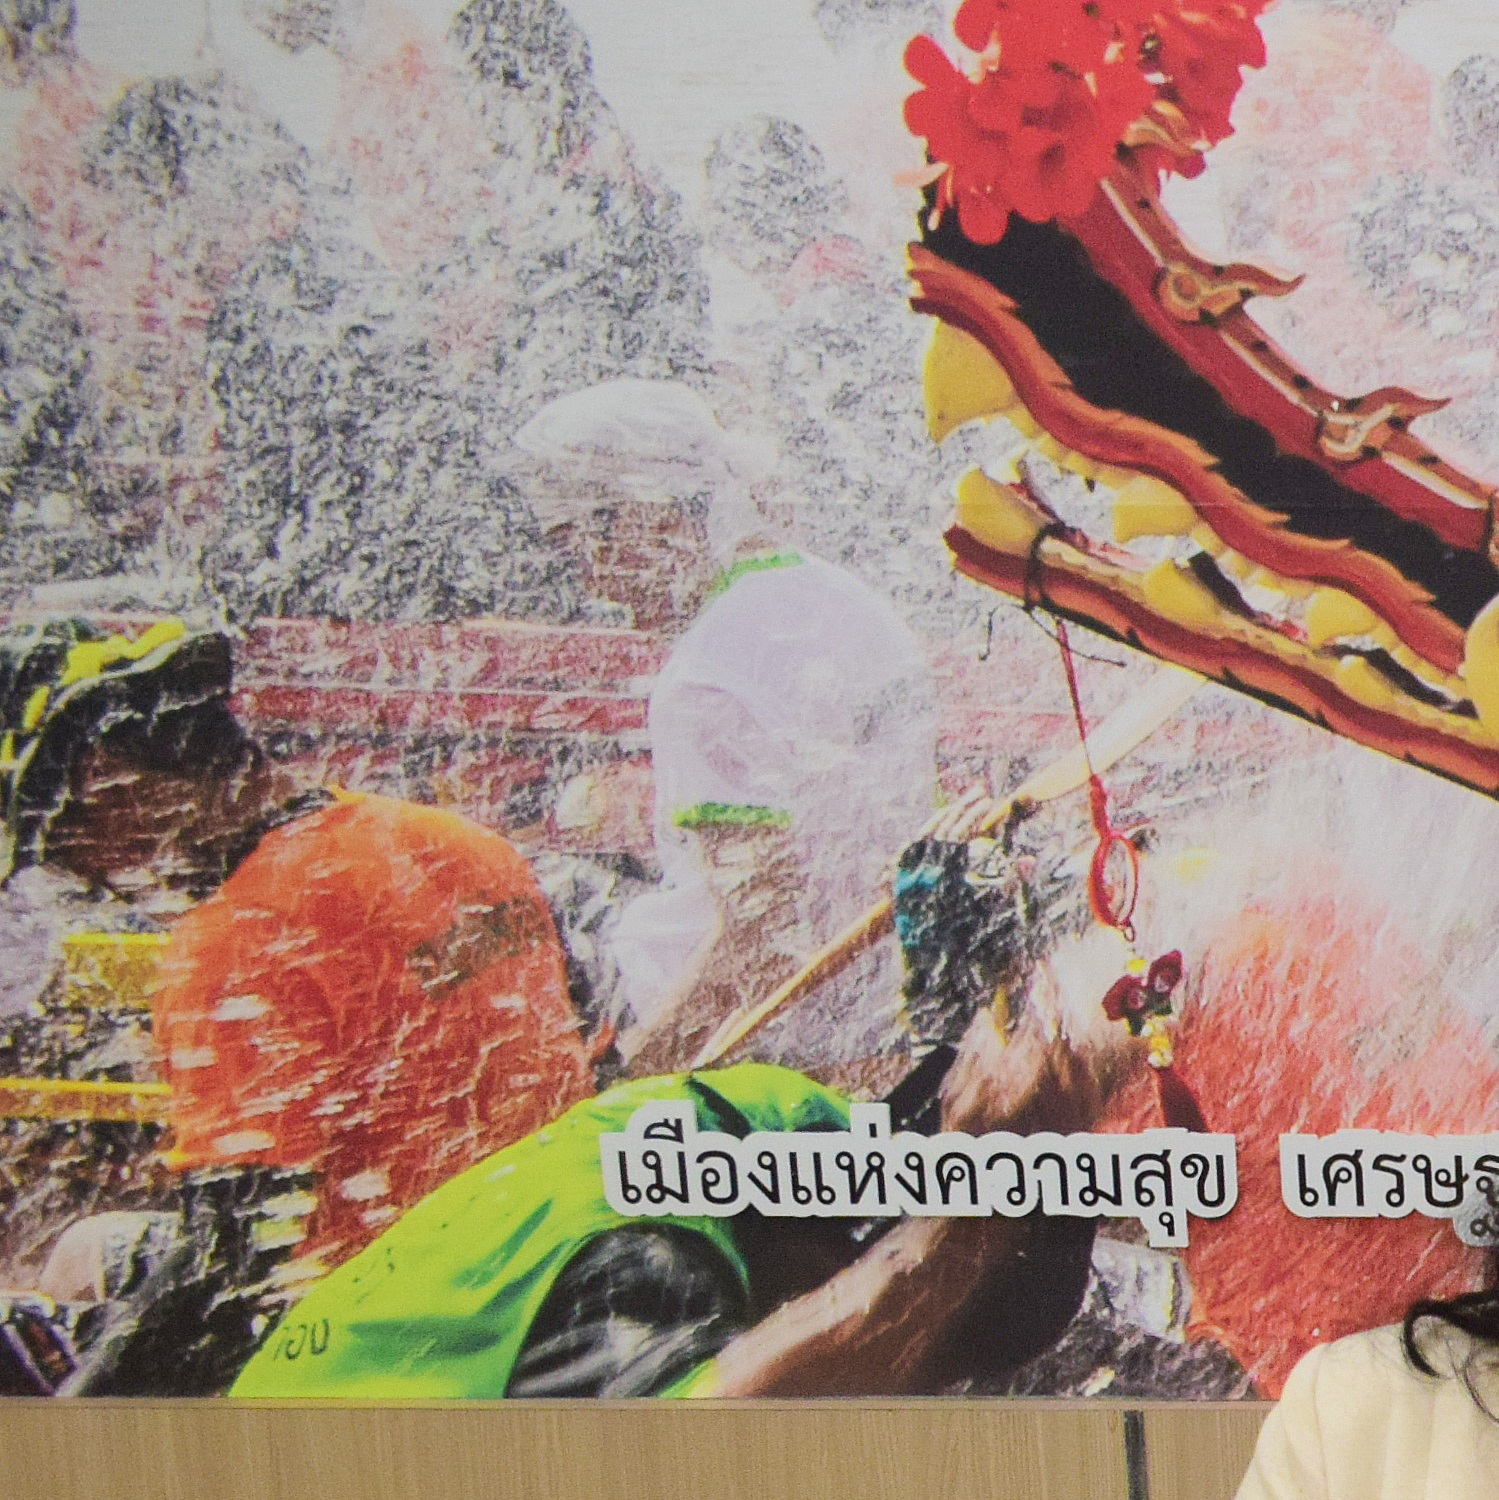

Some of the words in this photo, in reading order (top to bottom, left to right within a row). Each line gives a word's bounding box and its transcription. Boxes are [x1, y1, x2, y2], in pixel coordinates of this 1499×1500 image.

[615, 1119, 1229, 1235] เมืองแห่งความสุข
